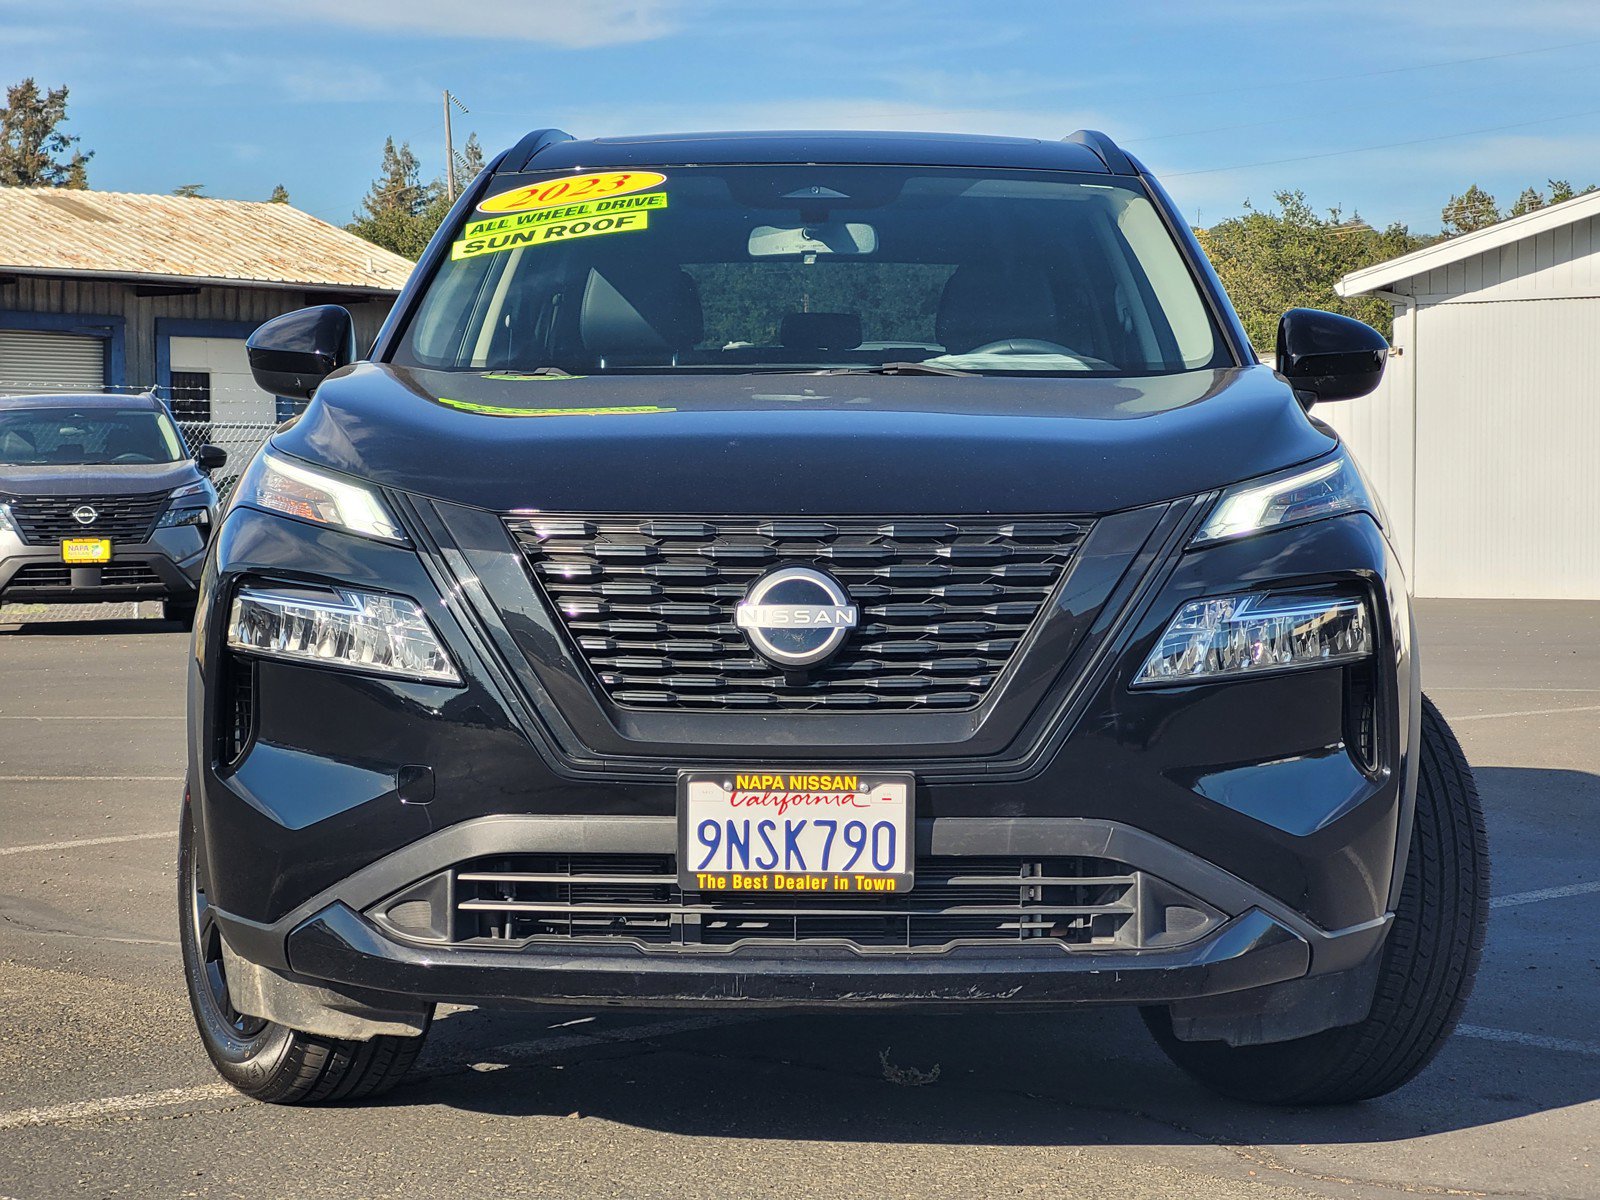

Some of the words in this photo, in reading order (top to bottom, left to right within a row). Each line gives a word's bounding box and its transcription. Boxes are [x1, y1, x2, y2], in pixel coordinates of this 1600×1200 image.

[504, 174, 631, 208] 2023
[469, 220, 509, 235] ALL
[517, 205, 590, 226] WHEEL
[598, 196, 661, 210] DRIVE
[463, 231, 536, 254] SUN
[544, 216, 636, 239] ROOF
[741, 609, 853, 624] NISSAN
[736, 775, 784, 790] NAPA
[789, 776, 857, 791] NISSAN
[730, 791, 871, 815] California
[697, 819, 896, 871] 9NSK790
[697, 874, 725, 889] The
[732, 874, 768, 890] Best
[774, 875, 827, 890] Dealer
[834, 875, 848, 890] in
[855, 876, 895, 891] Town
